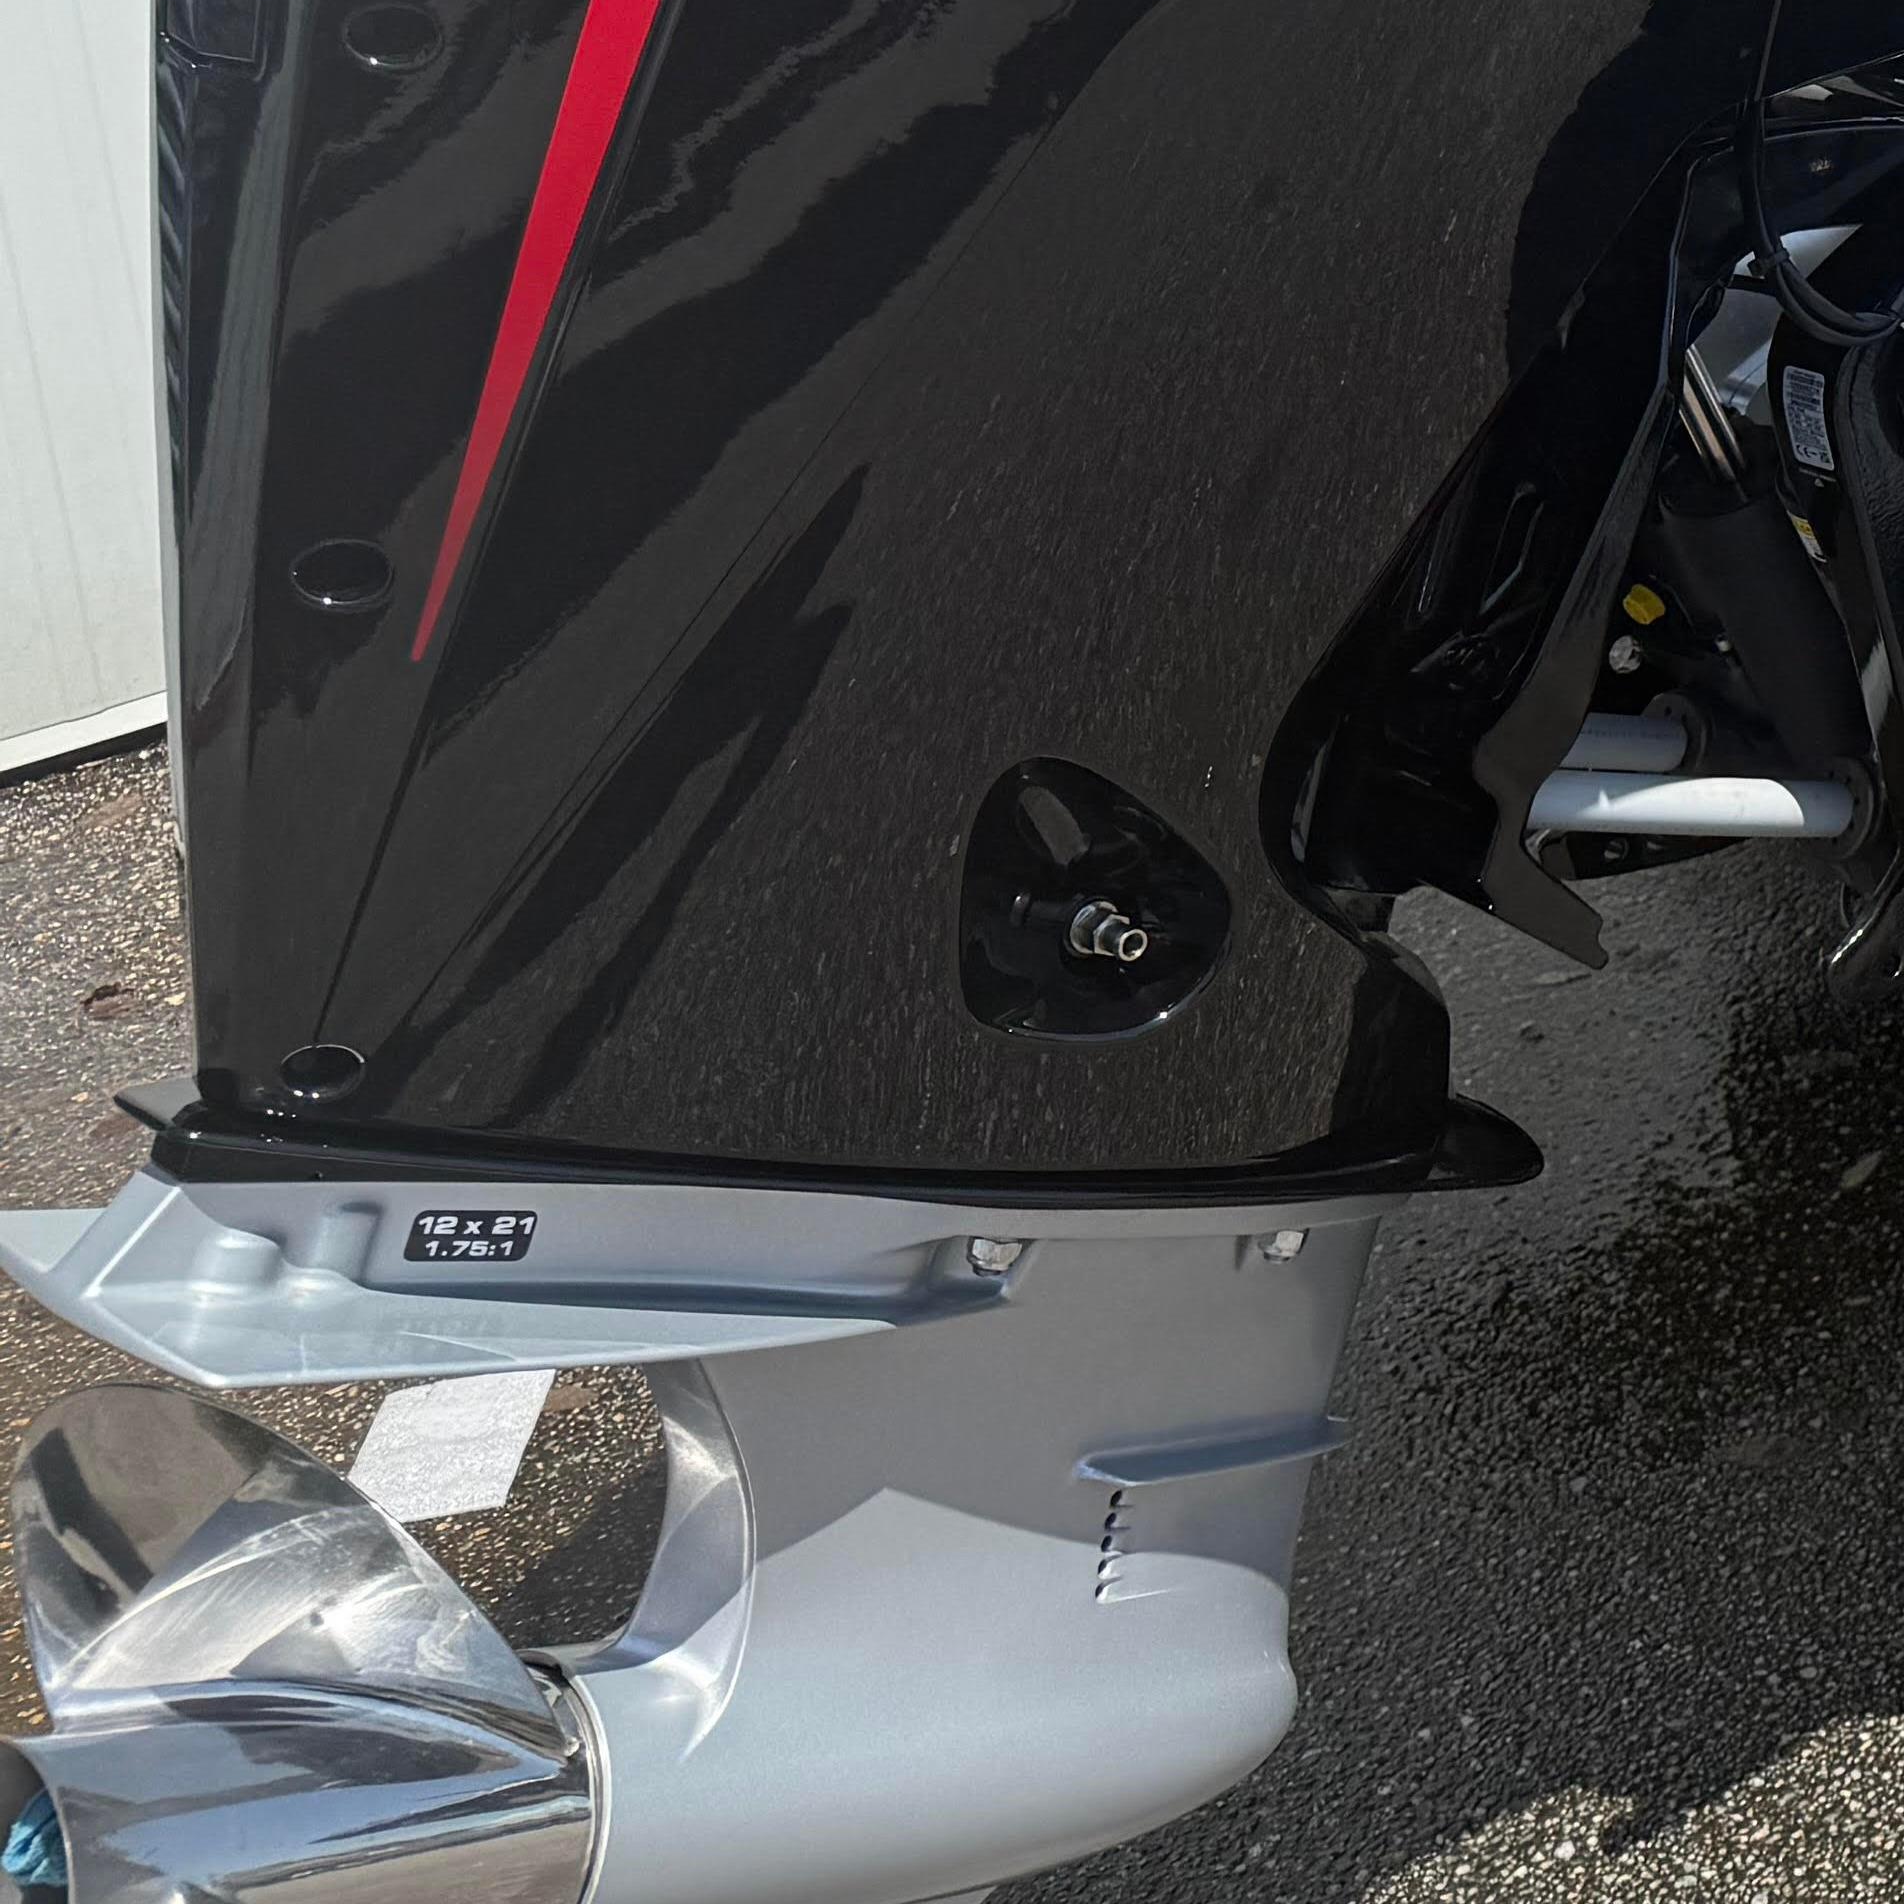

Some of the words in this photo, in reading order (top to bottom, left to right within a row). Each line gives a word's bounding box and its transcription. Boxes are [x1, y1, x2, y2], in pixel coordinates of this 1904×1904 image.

[418, 1216, 459, 1235] 12
[463, 1221, 484, 1235] x
[491, 1216, 535, 1235] 21
[425, 1240, 515, 1257] 1.75:1
